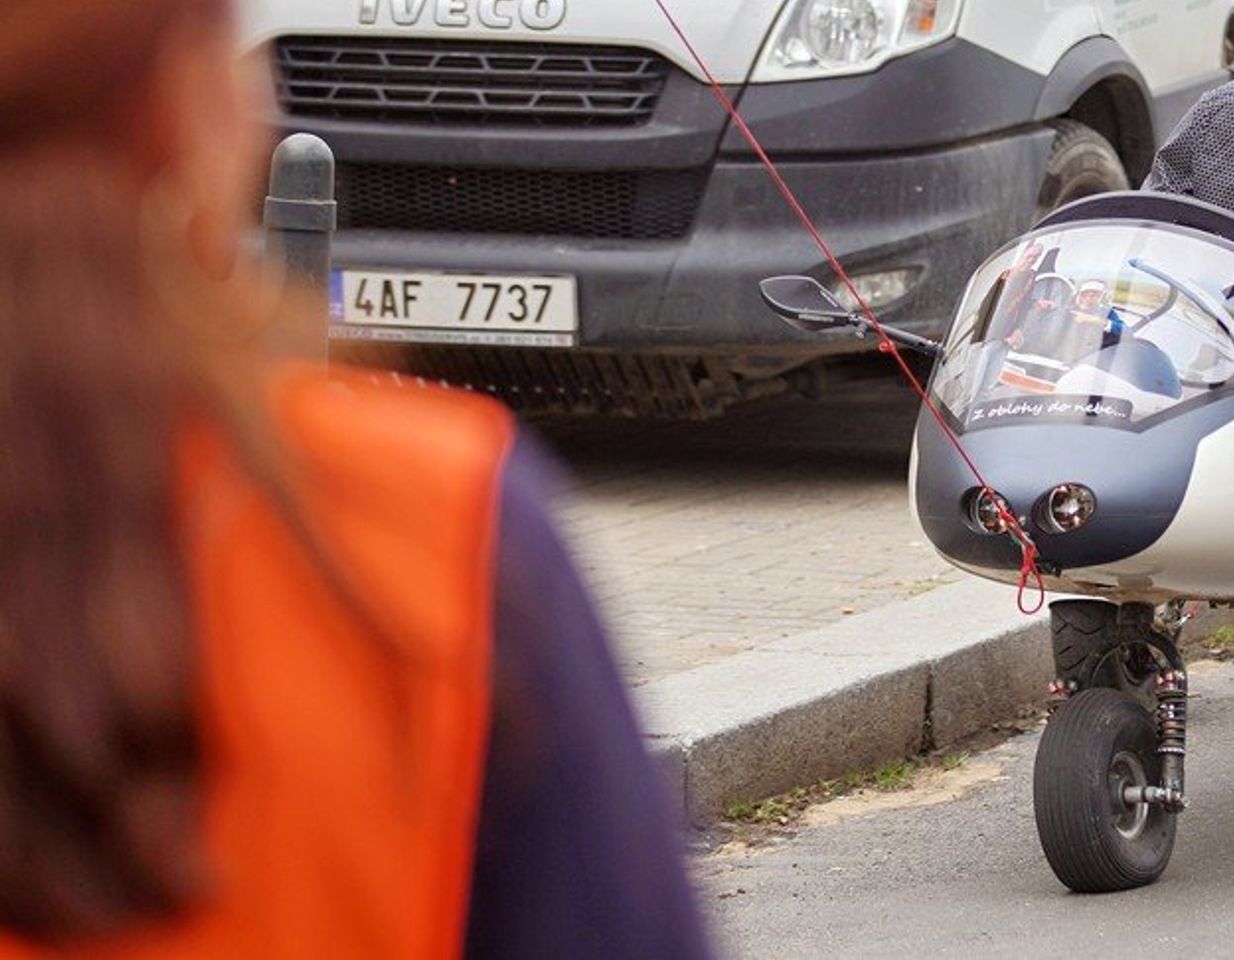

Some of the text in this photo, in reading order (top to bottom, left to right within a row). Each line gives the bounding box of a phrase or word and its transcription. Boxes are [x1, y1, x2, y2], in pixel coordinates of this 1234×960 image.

[355, 278, 553, 323] 4AF 7737
[987, 402, 1043, 417] oblohy
[1047, 400, 1070, 413] do
